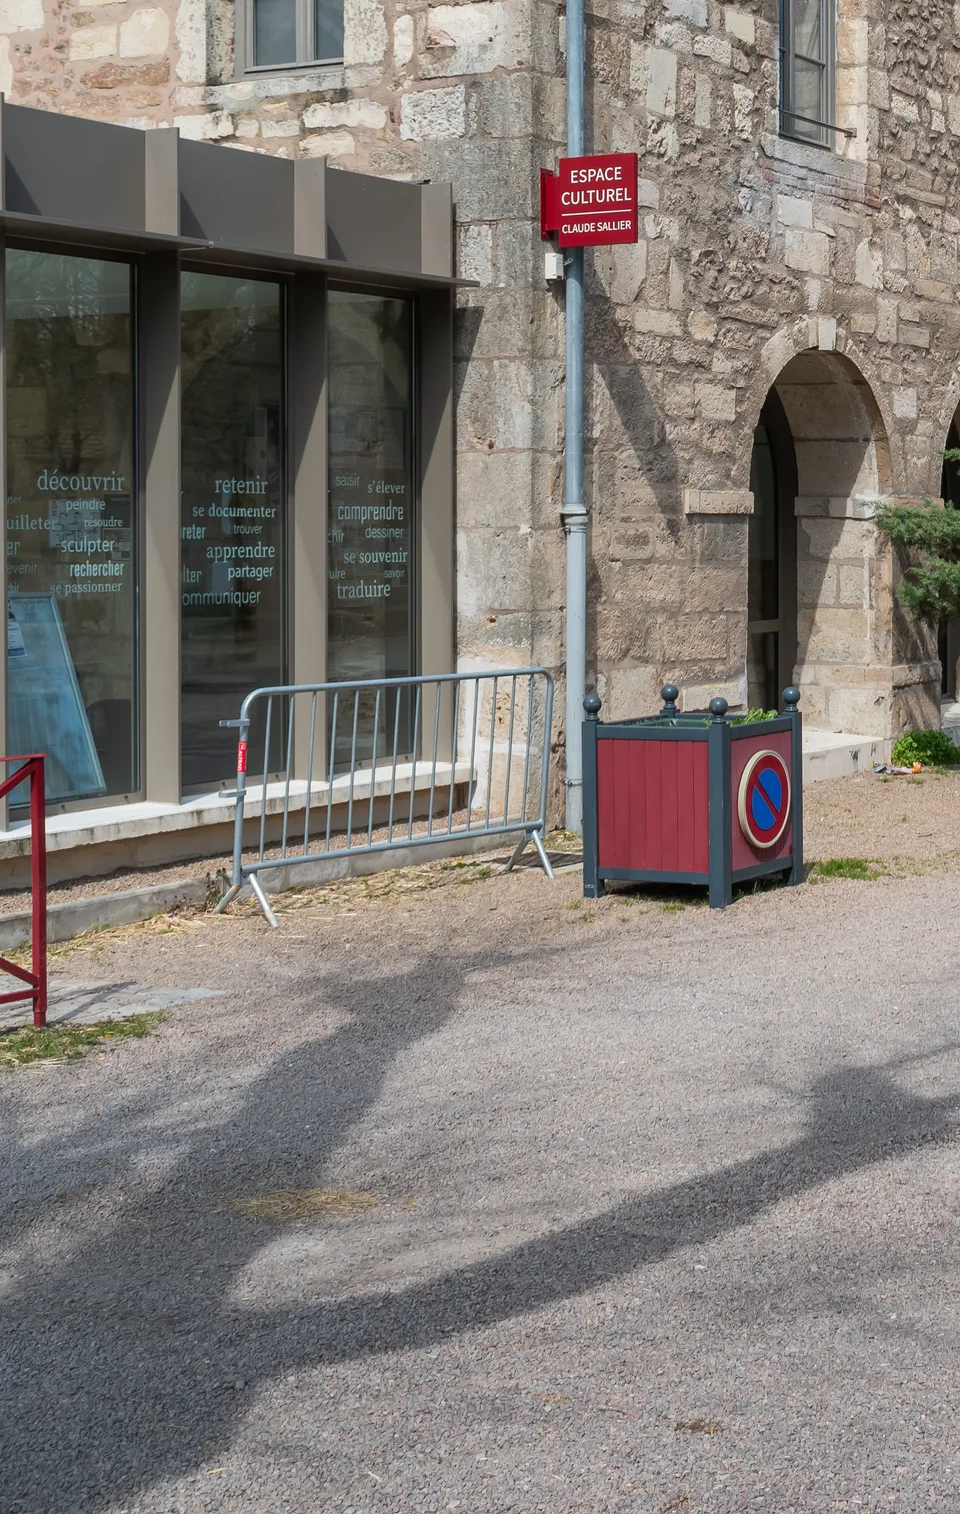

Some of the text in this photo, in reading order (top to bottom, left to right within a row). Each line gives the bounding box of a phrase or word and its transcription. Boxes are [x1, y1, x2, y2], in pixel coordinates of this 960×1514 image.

[570, 166, 622, 184] ESPACE
[561, 187, 632, 206] CULTUREL
[562, 220, 632, 234] CLAUDE SALLIER
[37, 469, 125, 491] découvrir
[215, 475, 268, 494] retenir
[335, 473, 360, 487] saisir
[65, 498, 106, 512] peindre
[192, 503, 277, 518] se documenter
[337, 499, 404, 525] comprendre
[83, 516, 123, 527] résoudre
[233, 523, 263, 535] trouver
[181, 523, 206, 540] reter
[365, 525, 404, 539] dessiner
[60, 536, 116, 556] sculpter
[206, 541, 276, 564] apprendre
[343, 548, 408, 564] se souvenir
[69, 559, 125, 577] rechercher
[228, 566, 273, 581] partager
[384, 567, 405, 578] savoir
[50, 580, 122, 596] se passionner
[337, 579, 391, 599] traduire
